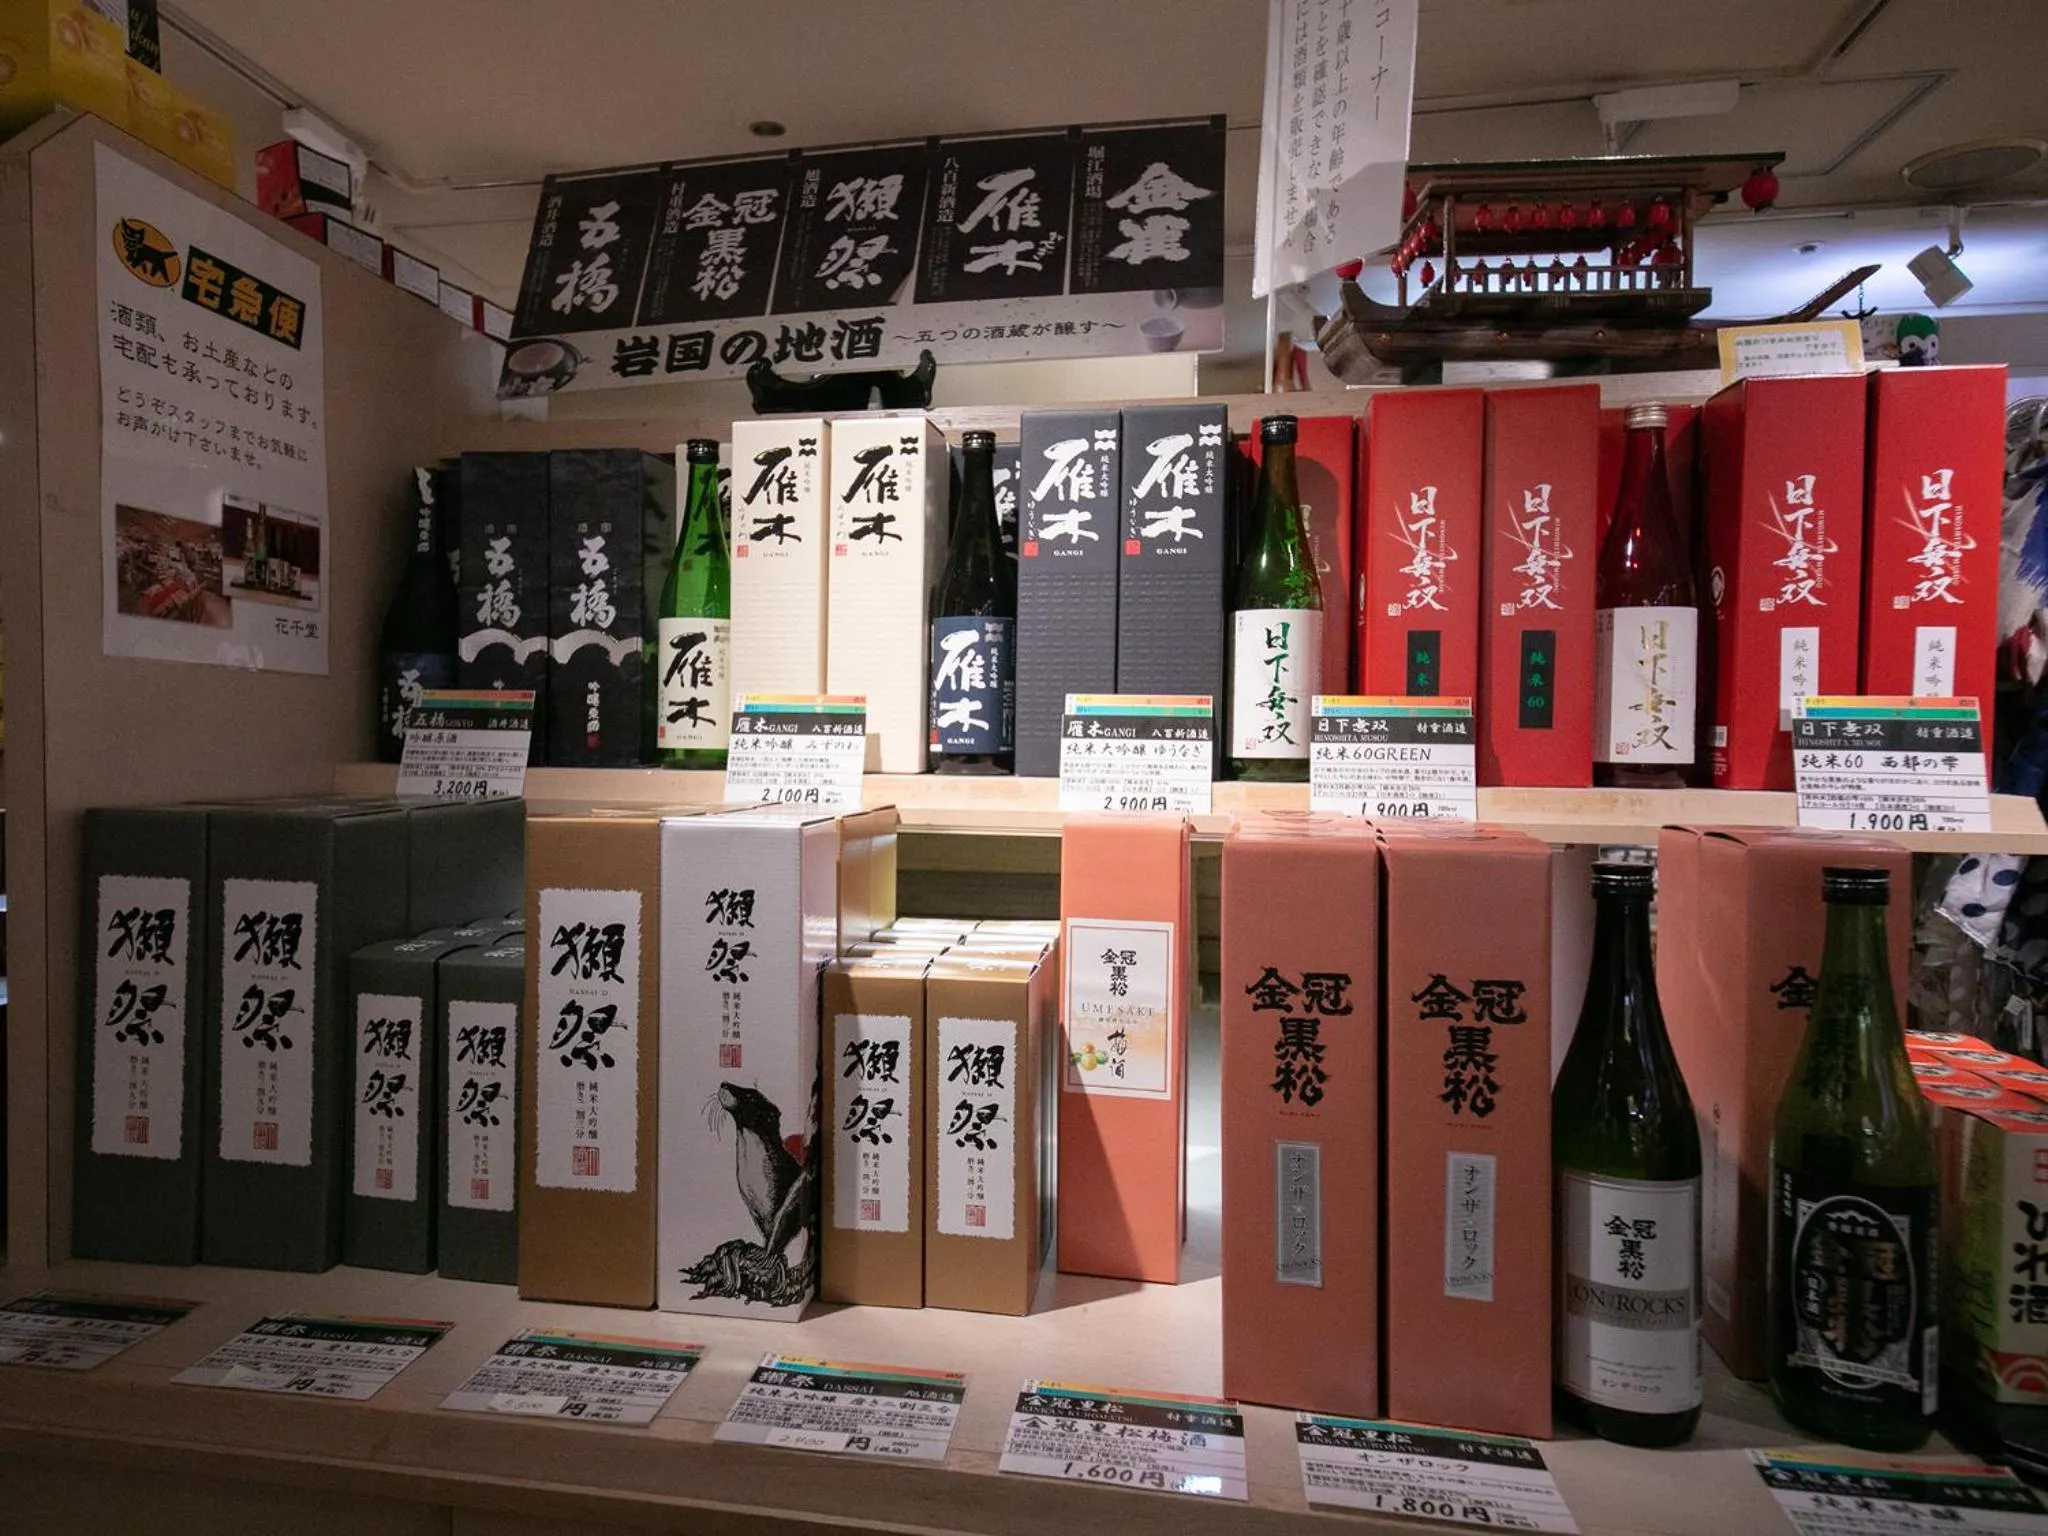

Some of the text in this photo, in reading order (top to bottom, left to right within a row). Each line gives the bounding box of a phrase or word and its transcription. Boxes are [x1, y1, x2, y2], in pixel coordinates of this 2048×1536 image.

[1371, 0, 1390, 121] コーナー
[550, 200, 622, 316] 五橋
[814, 173, 905, 292] 獺祭
[188, 257, 301, 343] 宅急便
[611, 316, 886, 379] 岩国の地酒
[743, 446, 802, 545] 雁木
[842, 445, 903, 545] 雁木
[1030, 437, 1100, 544] 雁木
[1131, 433, 1203, 543] 雁木
[1905, 468, 1965, 606] 日下無双
[1399, 485, 1450, 612] 日下無双
[1513, 483, 1565, 611] 日下無双
[1773, 474, 1828, 607] 日下無双
[663, 632, 717, 728] 雁木
[934, 629, 990, 732] 雁木
[1256, 621, 1301, 747] 日下無双
[1317, 717, 1390, 733] 日下無双
[1800, 721, 1886, 738] 日下無双
[761, 787, 820, 804] 2100円
[1066, 741, 1147, 757] 純米大吟醸
[1800, 752, 1865, 770] 純米60
[1103, 795, 1167, 811] 2900円
[1360, 801, 1430, 818] 1900円
[105, 906, 177, 1048] 獺祭
[232, 910, 305, 1053] 獺祭
[705, 888, 758, 985] 獺祭
[548, 920, 628, 1072] 獺祭
[362, 1017, 414, 1120] 獺祭
[456, 1025, 509, 1128] 獺祭
[841, 1038, 903, 1147] 獺祭
[946, 1042, 1008, 1152] 獺祭
[1617, 1292, 1688, 1316] ROCKS
[845, 1435, 873, 1452] 円
[1355, 1452, 1471, 1473] オンザロック
